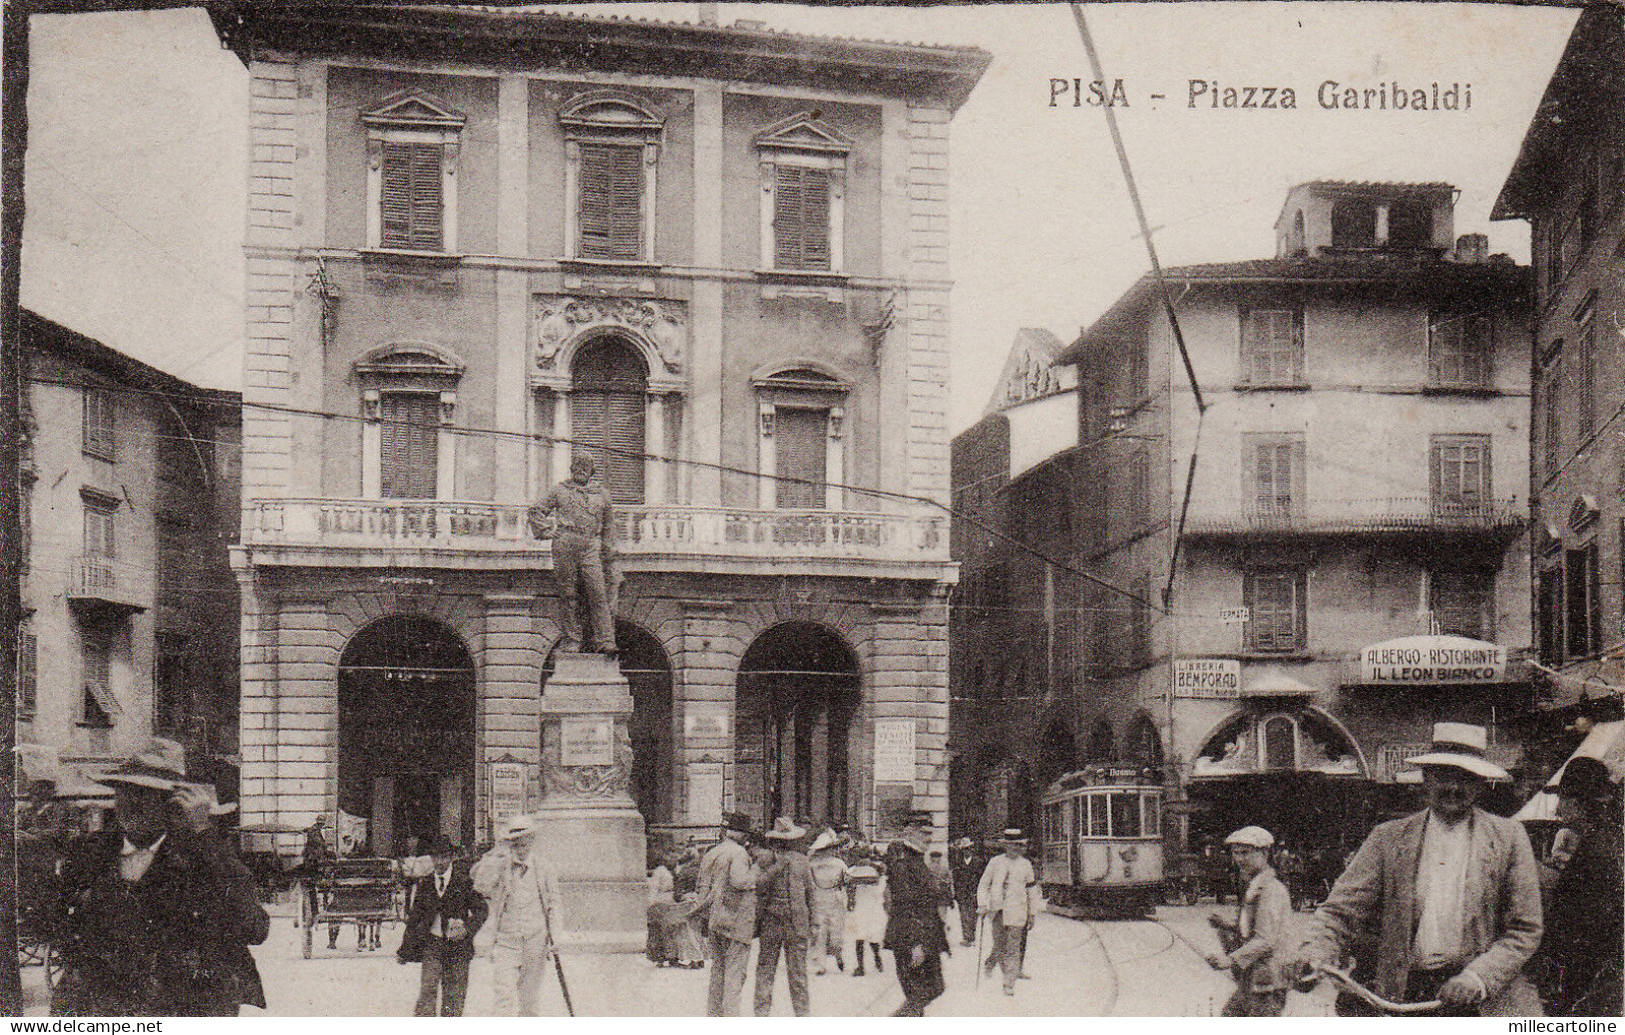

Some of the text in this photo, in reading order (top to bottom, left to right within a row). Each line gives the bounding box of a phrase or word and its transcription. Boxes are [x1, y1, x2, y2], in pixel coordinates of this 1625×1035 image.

[1367, 649, 1421, 665] ALBERGO
[1429, 649, 1501, 665] RISTORANTE
[1178, 662, 1224, 671] LIBRERIA
[1372, 667, 1495, 681] IL LEON BIANCO
[1178, 671, 1238, 688] BEMPORAD
